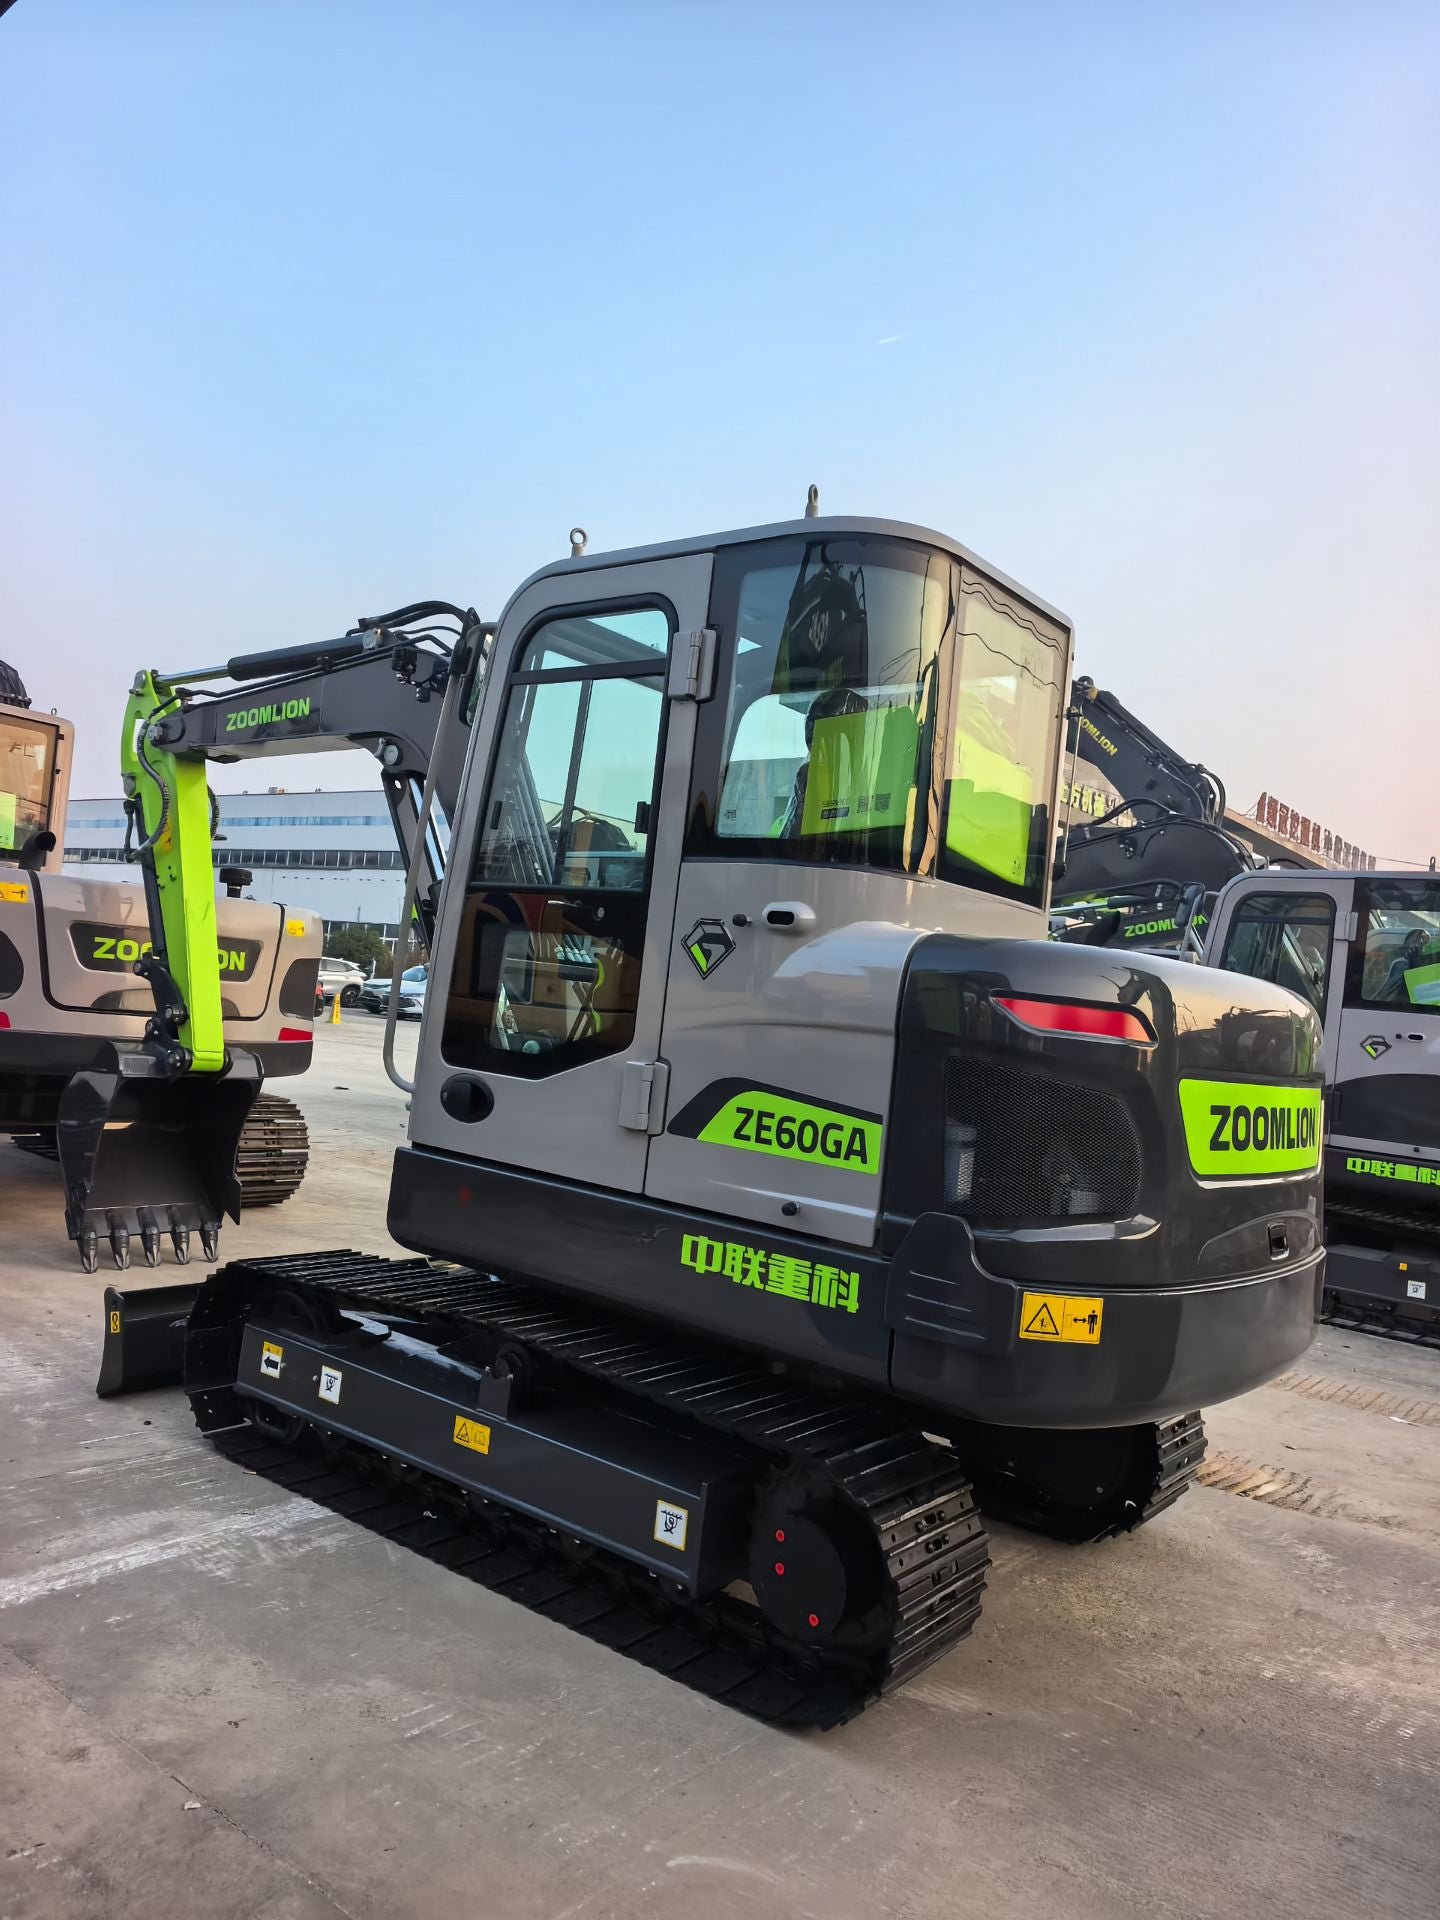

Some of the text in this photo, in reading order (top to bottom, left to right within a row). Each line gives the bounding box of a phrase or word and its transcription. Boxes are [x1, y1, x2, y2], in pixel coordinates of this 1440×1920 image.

[226, 697, 310, 731] ZOOMLION
[1070, 706, 1118, 756] OMLION
[1124, 914, 1208, 937] ZOOMLN
[93, 937, 245, 971] ZOON
[733, 1107, 868, 1164] ZE60GA
[1209, 1105, 1316, 1151] ZOOMLION
[681, 1234, 859, 1313] 中联重科
